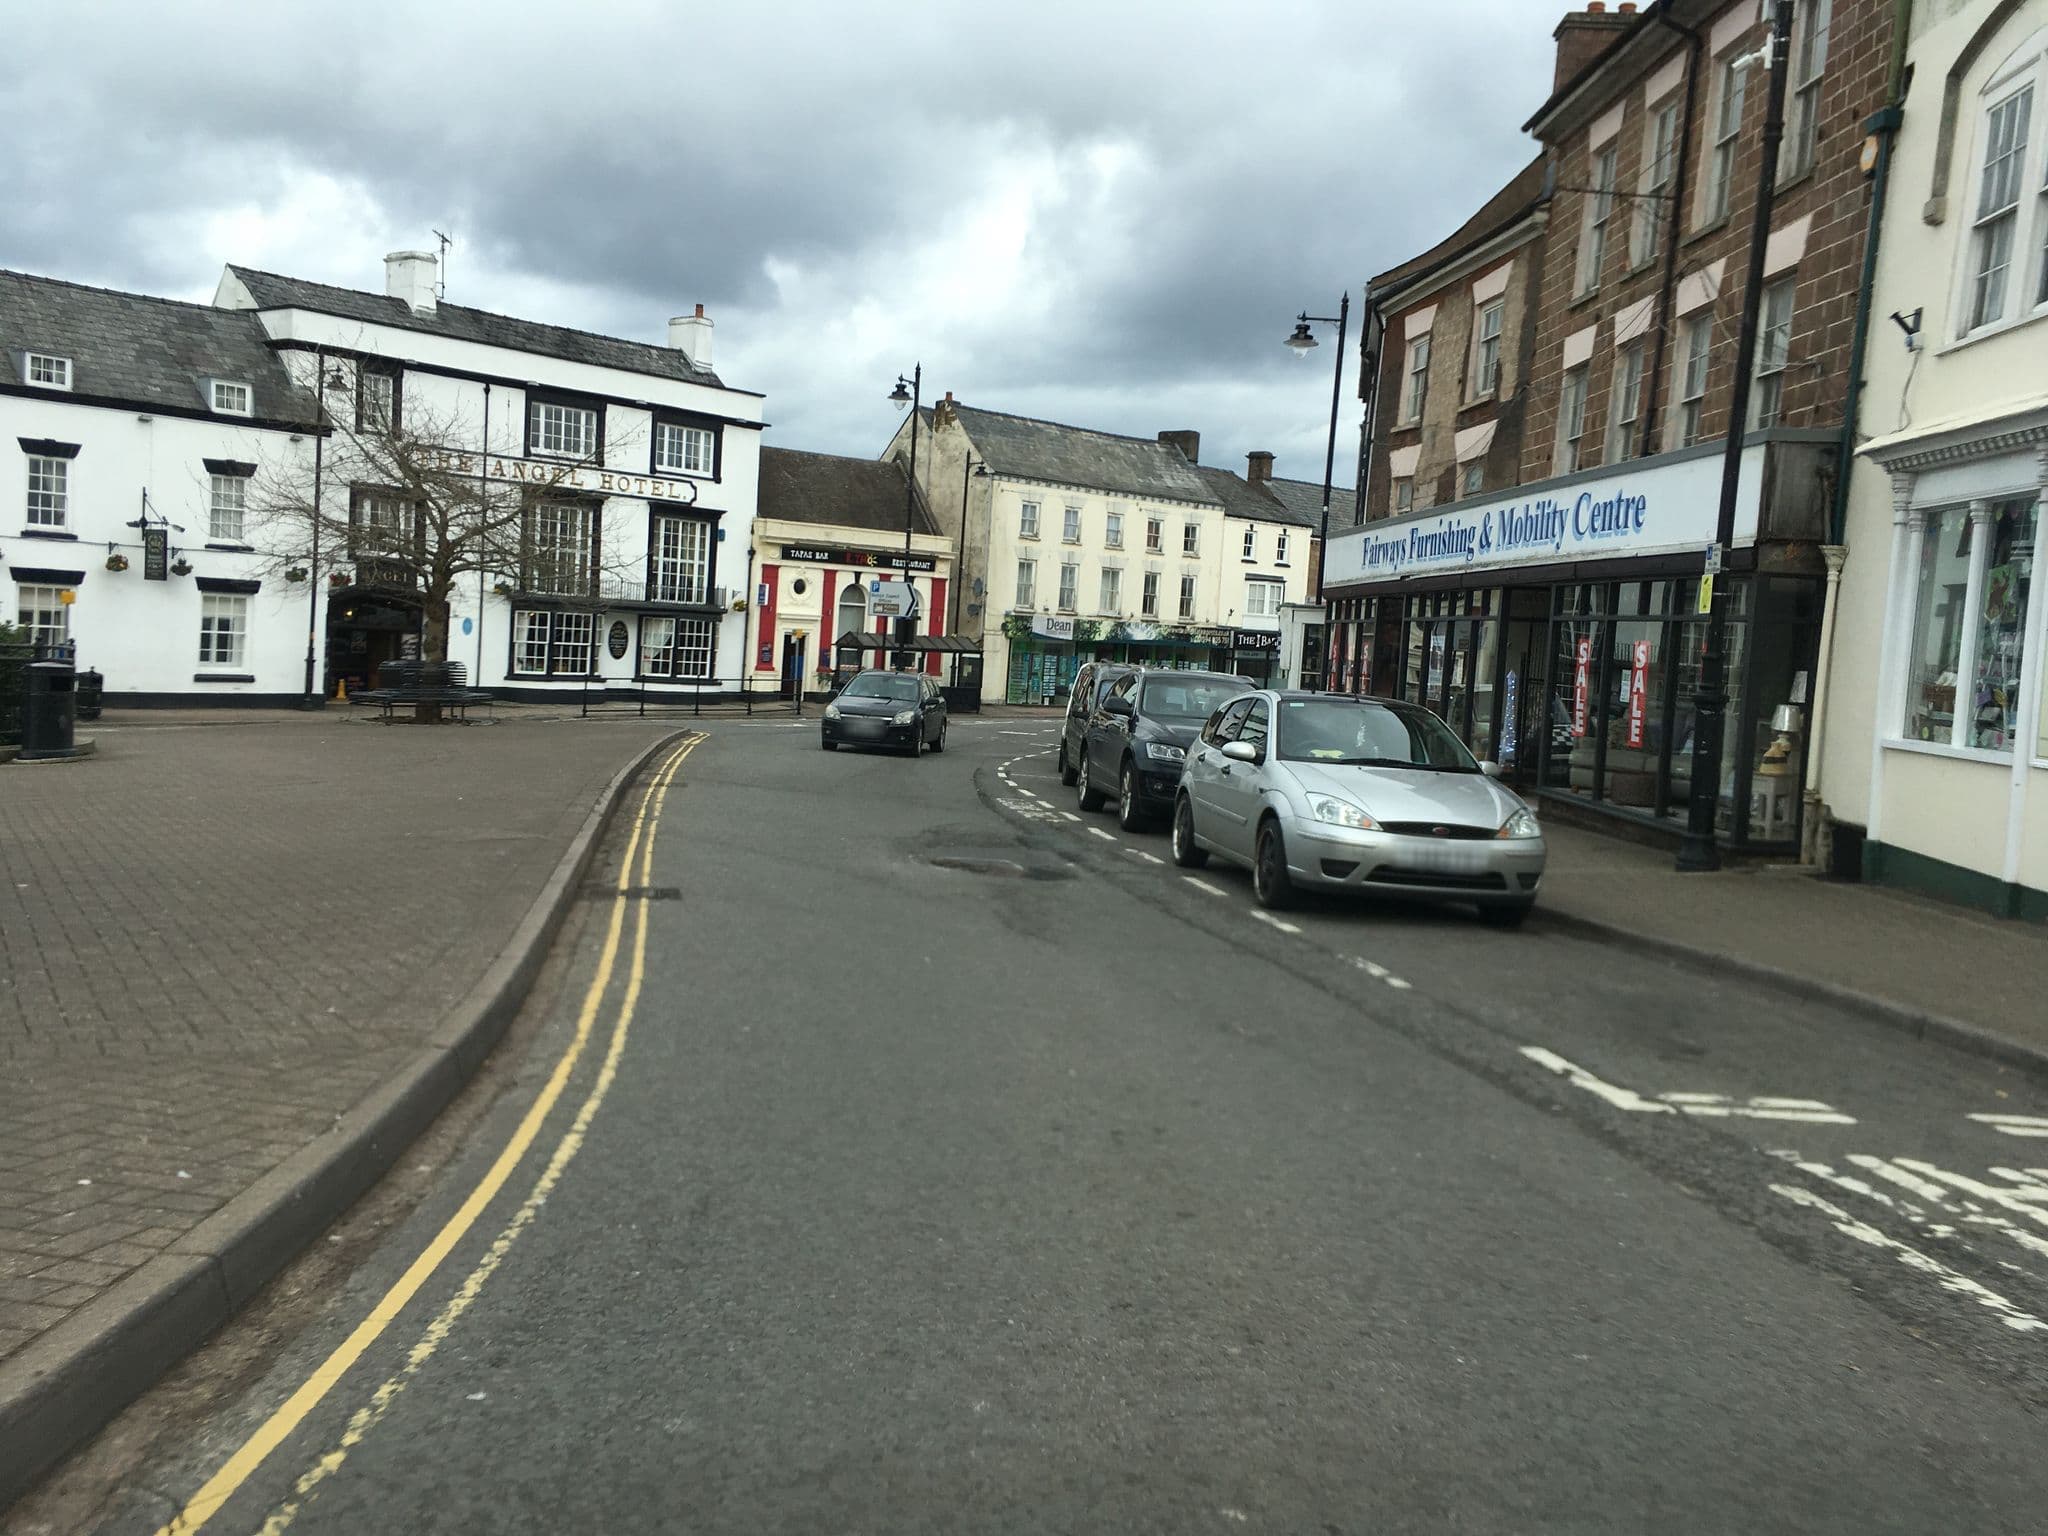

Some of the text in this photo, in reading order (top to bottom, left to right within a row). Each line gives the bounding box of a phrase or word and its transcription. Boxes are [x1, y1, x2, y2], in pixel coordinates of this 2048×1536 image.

[417, 447, 474, 473] THE
[490, 459, 584, 487] ANGEL
[1362, 490, 1647, 570] Fairways Furnishing & Mobility Centre
[790, 549, 829, 560] TAPAS BAR
[892, 558, 931, 569] RESTURANT
[1046, 617, 1072, 632] Dean
[1237, 634, 1255, 645] THE
[1575, 642, 1588, 733] SALE
[1630, 644, 1647, 743] SALE
